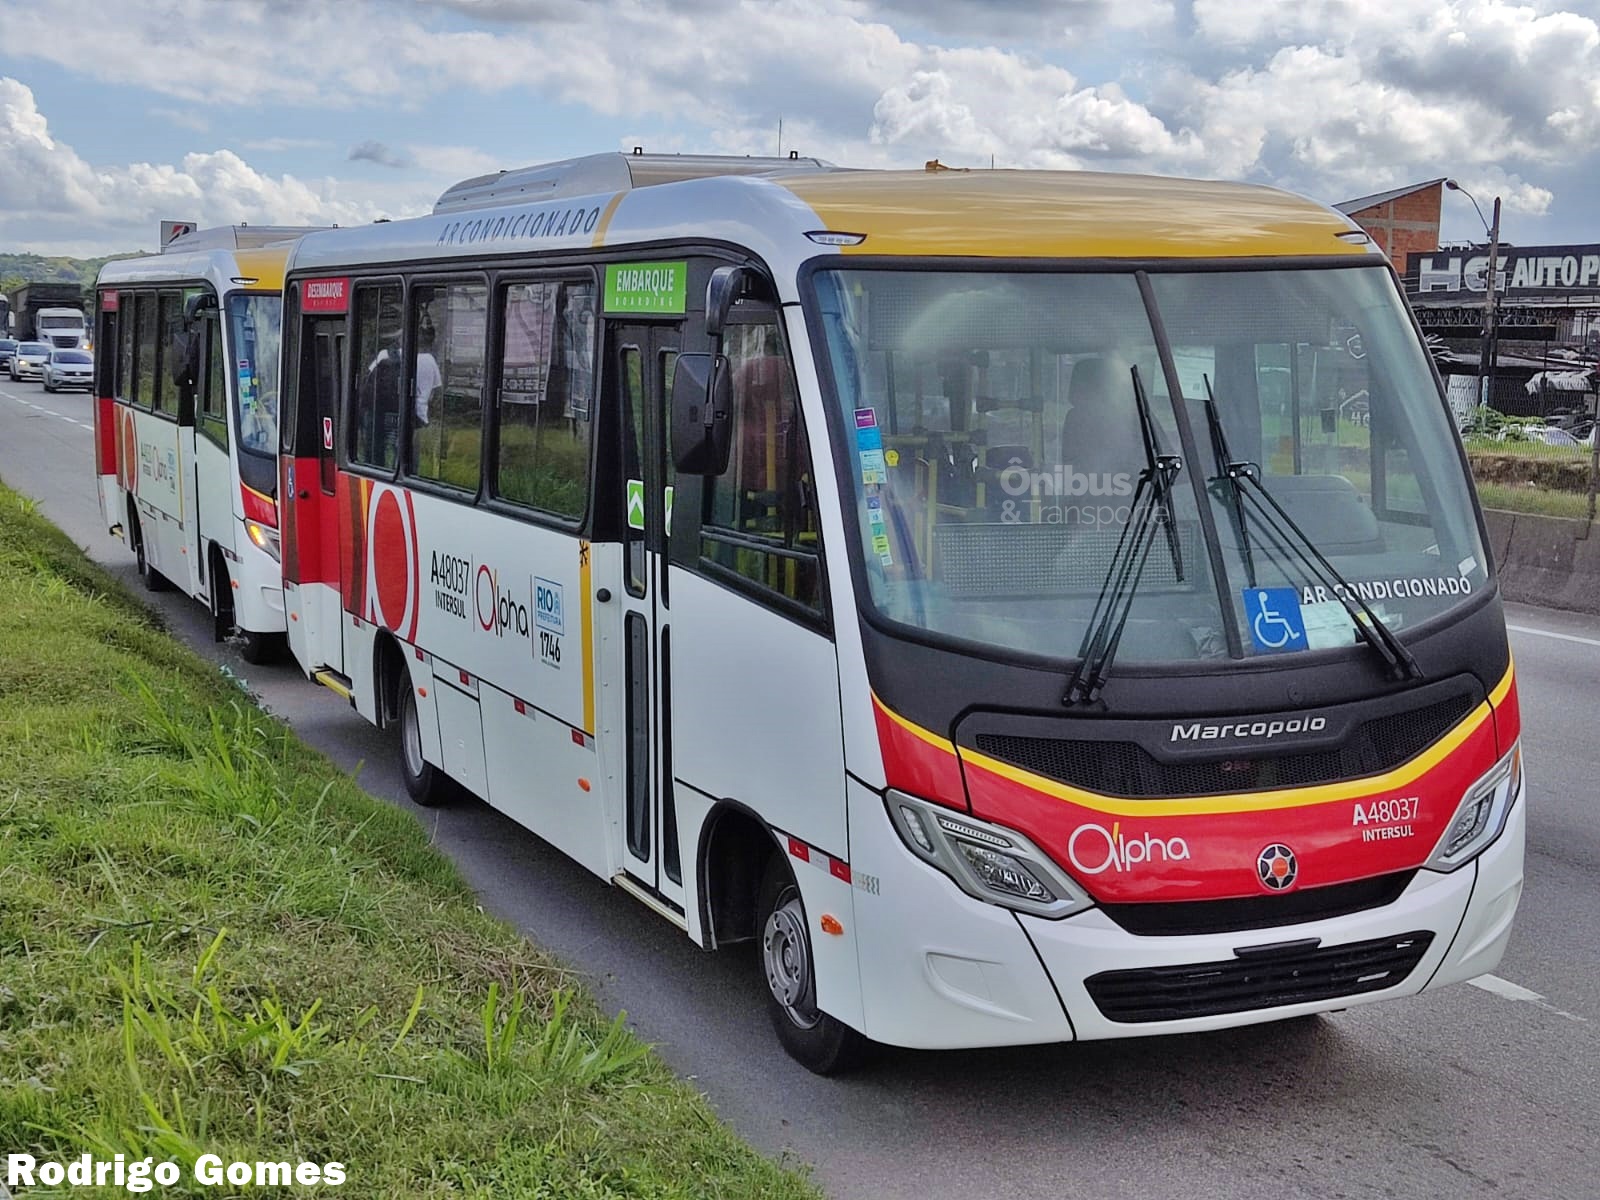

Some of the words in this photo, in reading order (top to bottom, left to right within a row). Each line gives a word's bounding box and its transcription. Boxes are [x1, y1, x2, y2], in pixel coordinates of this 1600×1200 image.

[616, 269, 674, 297] EMBARQUE
[1510, 256, 1578, 287] AUTO
[1579, 255, 1600, 286] P
[615, 296, 674, 307] BOARDING
[431, 550, 469, 596] A48037
[435, 589, 466, 619] INTERSUL
[537, 586, 553, 613] RIO
[1303, 585, 1328, 605] AR
[1334, 576, 1472, 602] CONDICIONADO
[540, 631, 561, 663] 1746
[1170, 716, 1326, 742] Marcopolo
[1353, 797, 1419, 826] A48037
[1362, 825, 1414, 842] INTERSUL
